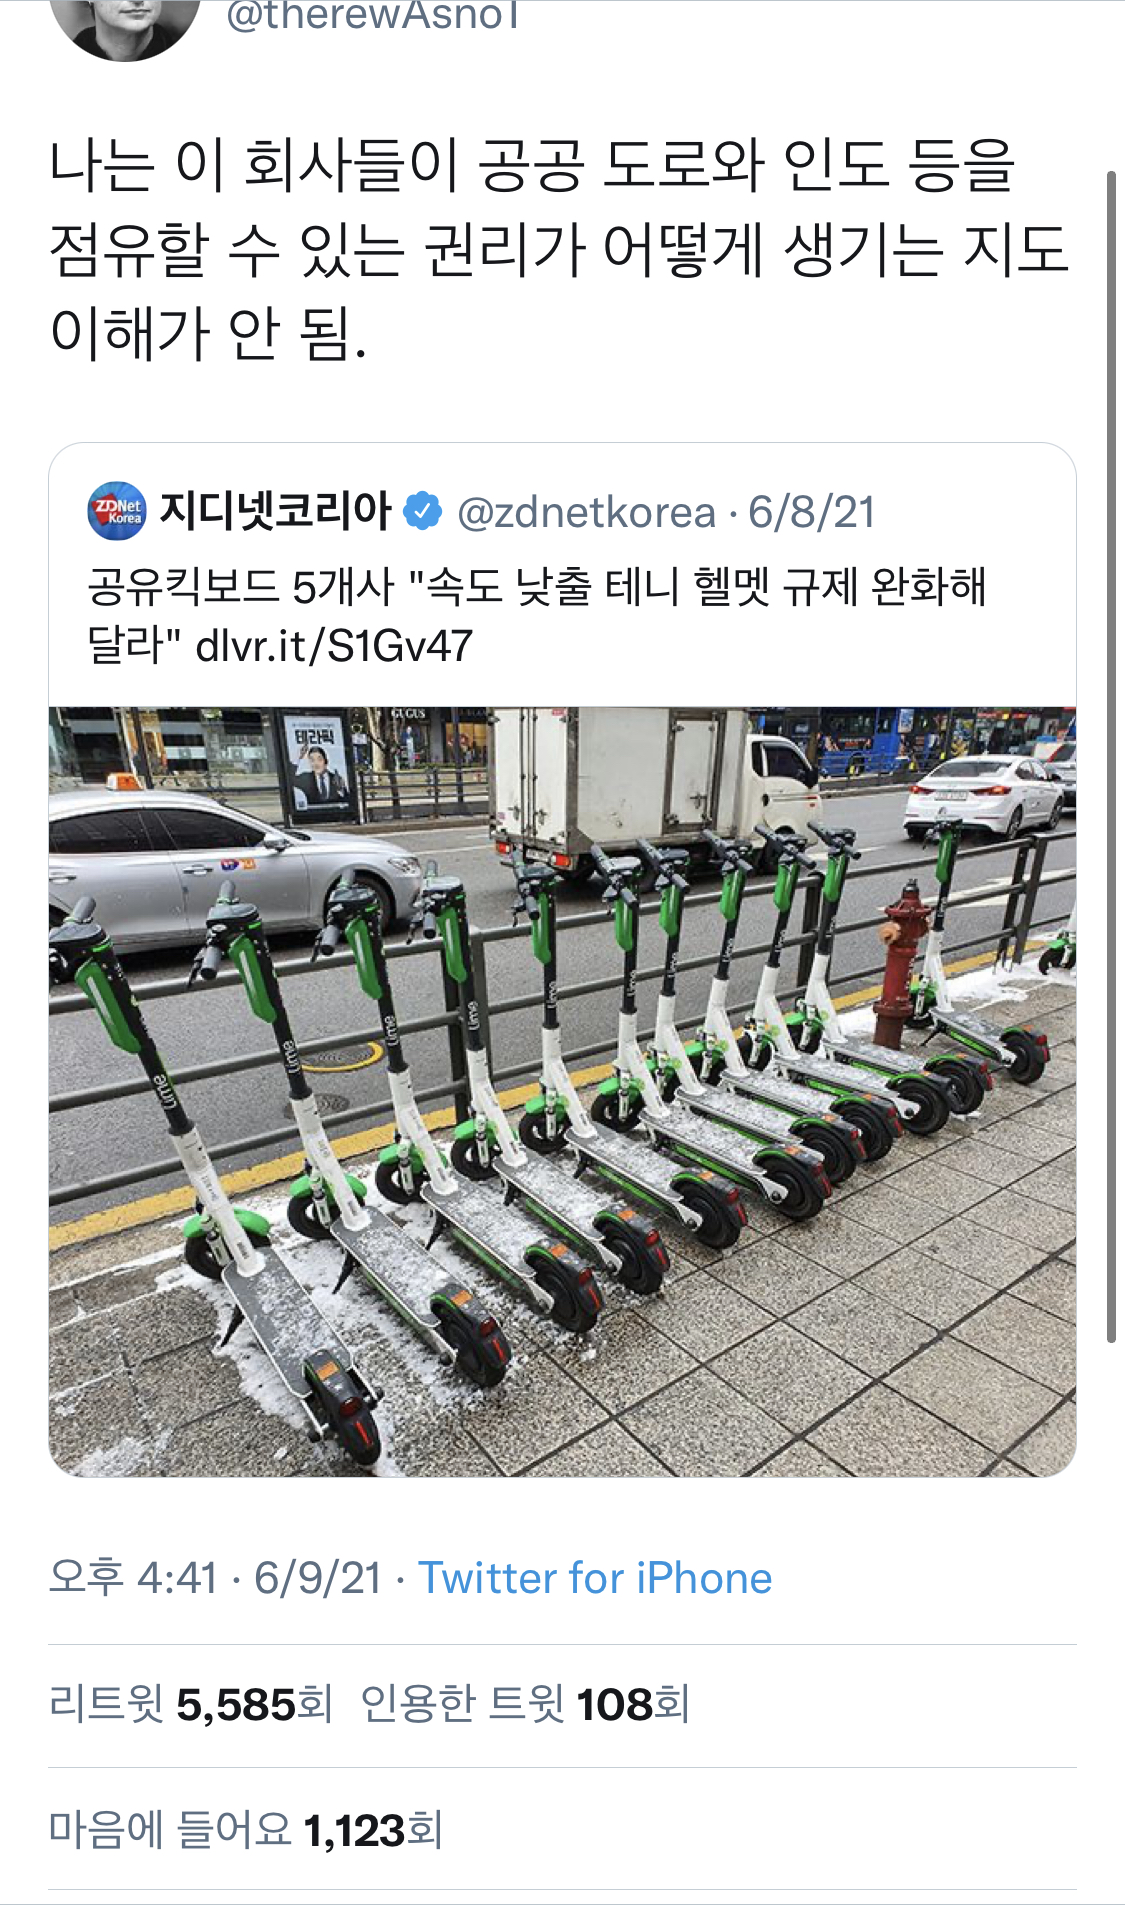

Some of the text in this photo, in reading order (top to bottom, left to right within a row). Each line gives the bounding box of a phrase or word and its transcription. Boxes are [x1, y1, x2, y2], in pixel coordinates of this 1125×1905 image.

[53, 137, 1014, 193] 나는 이 회사들이 공공 도로와 인도 등을
[50, 222, 1068, 278] 점유할 수 있는 권리가 어떻게 생기는 지도
[53, 306, 365, 362] 이해가 안 됨.
[95, 500, 142, 512] ZDNet
[109, 512, 142, 523] Korea
[160, 490, 871, 532] 지디넷코리아 @zdnetkorea 6/8/21
[88, 567, 984, 607] 공유킥보드 5개사 "속도 낮출 테니 헬멧 규제 완화해
[90, 625, 473, 666] 달라" dlvr.it/S1Gv47
[50, 1557, 771, 1598] 오후 4:41 6/9/21 Twitter for iPhone
[52, 1684, 687, 1727] 리트윗 5,585회 인용한 트윗 108회
[51, 1810, 440, 1853] 마음에 들어요 1,123회
